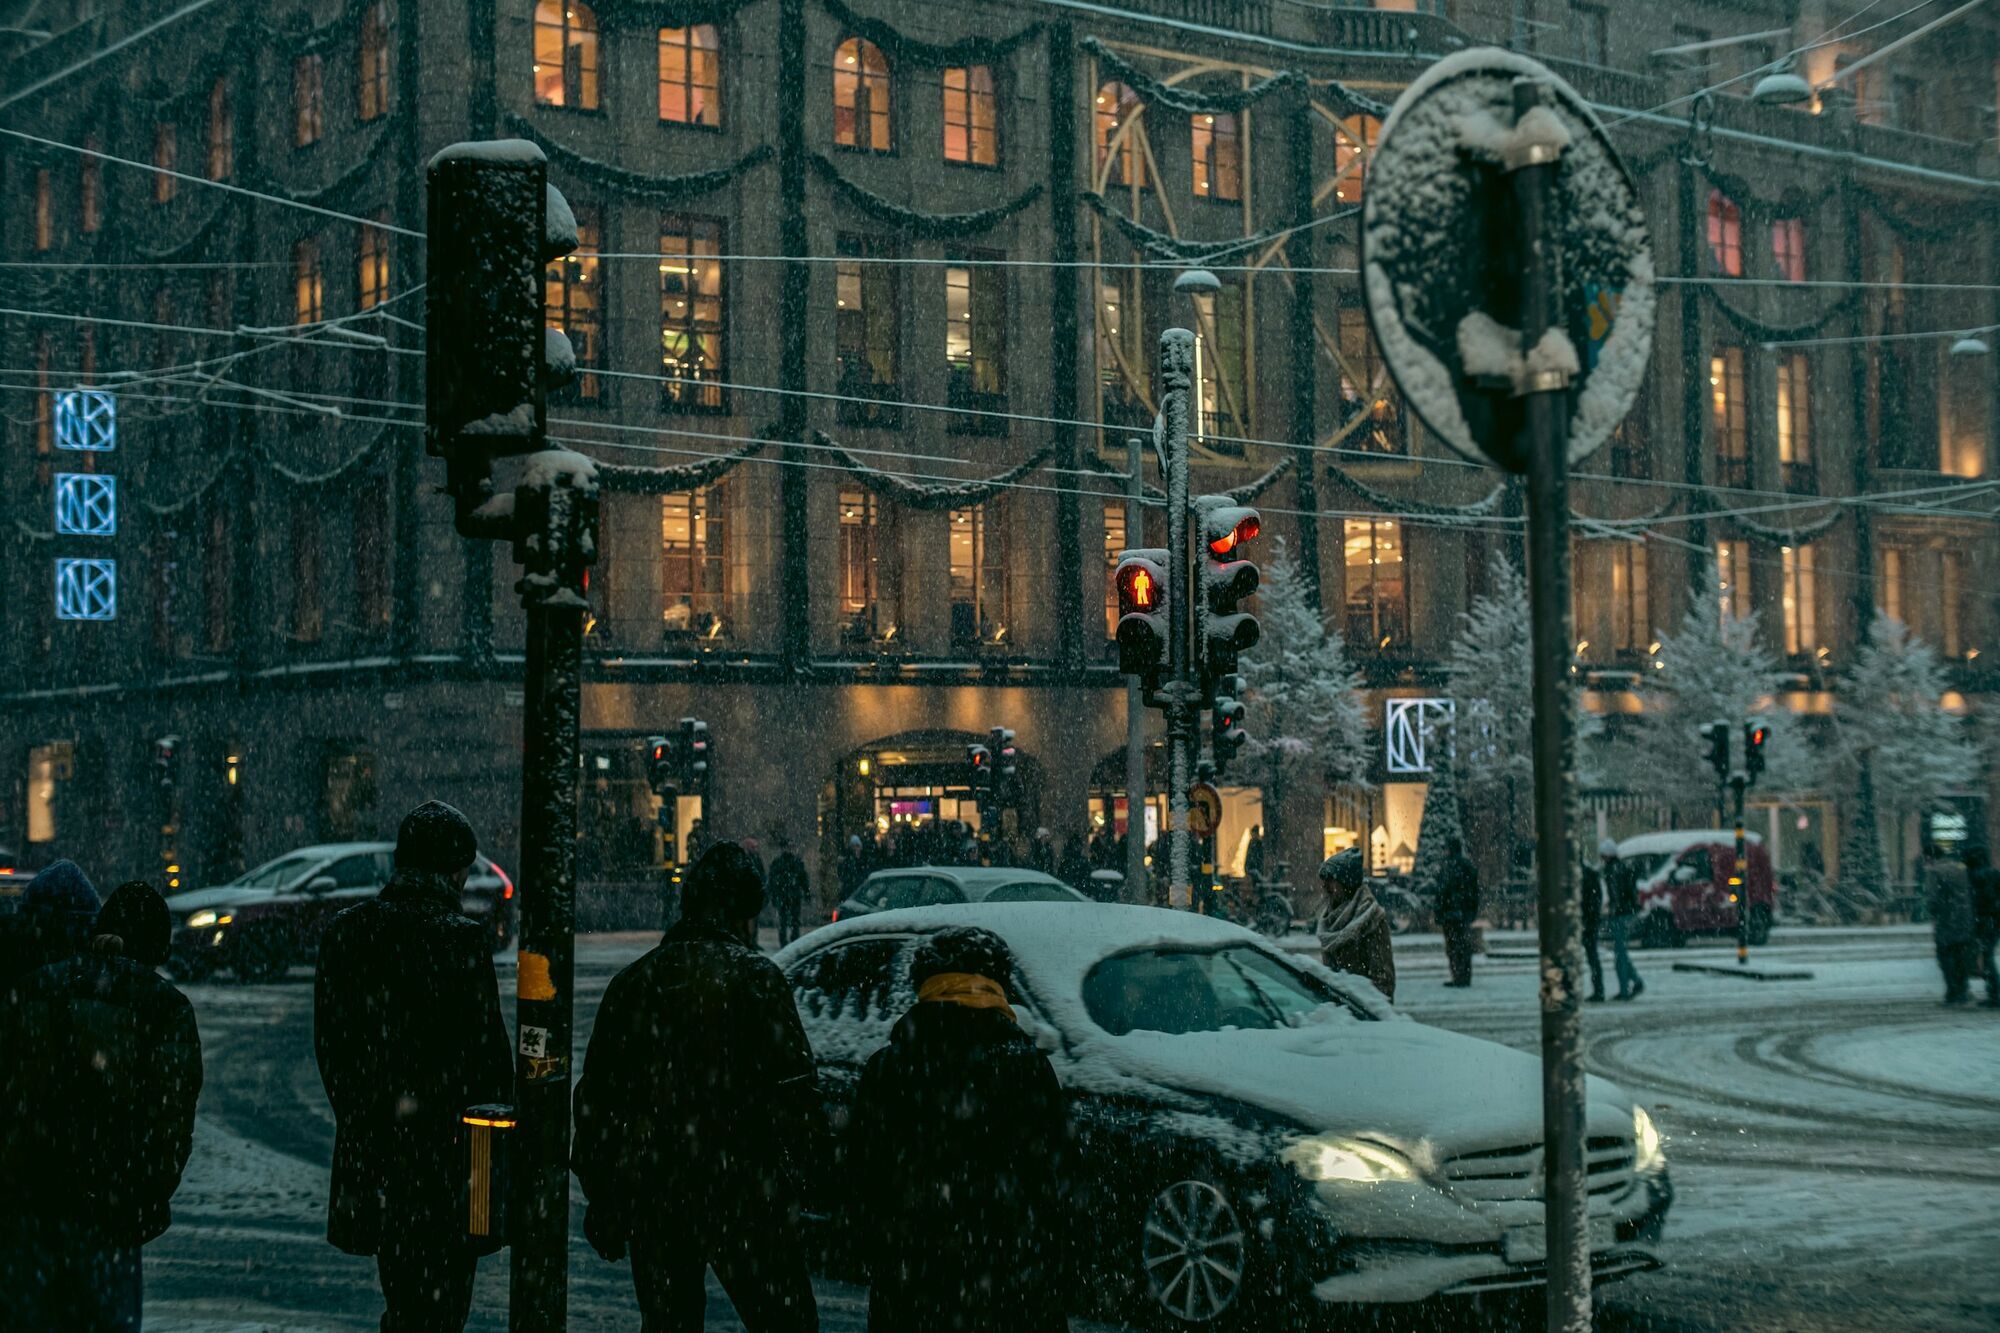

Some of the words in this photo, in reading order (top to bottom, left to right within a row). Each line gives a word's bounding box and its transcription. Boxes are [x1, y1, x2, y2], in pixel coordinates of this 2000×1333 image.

[61, 391, 114, 450] NK
[61, 475, 114, 533] NK
[61, 560, 114, 618] NK
